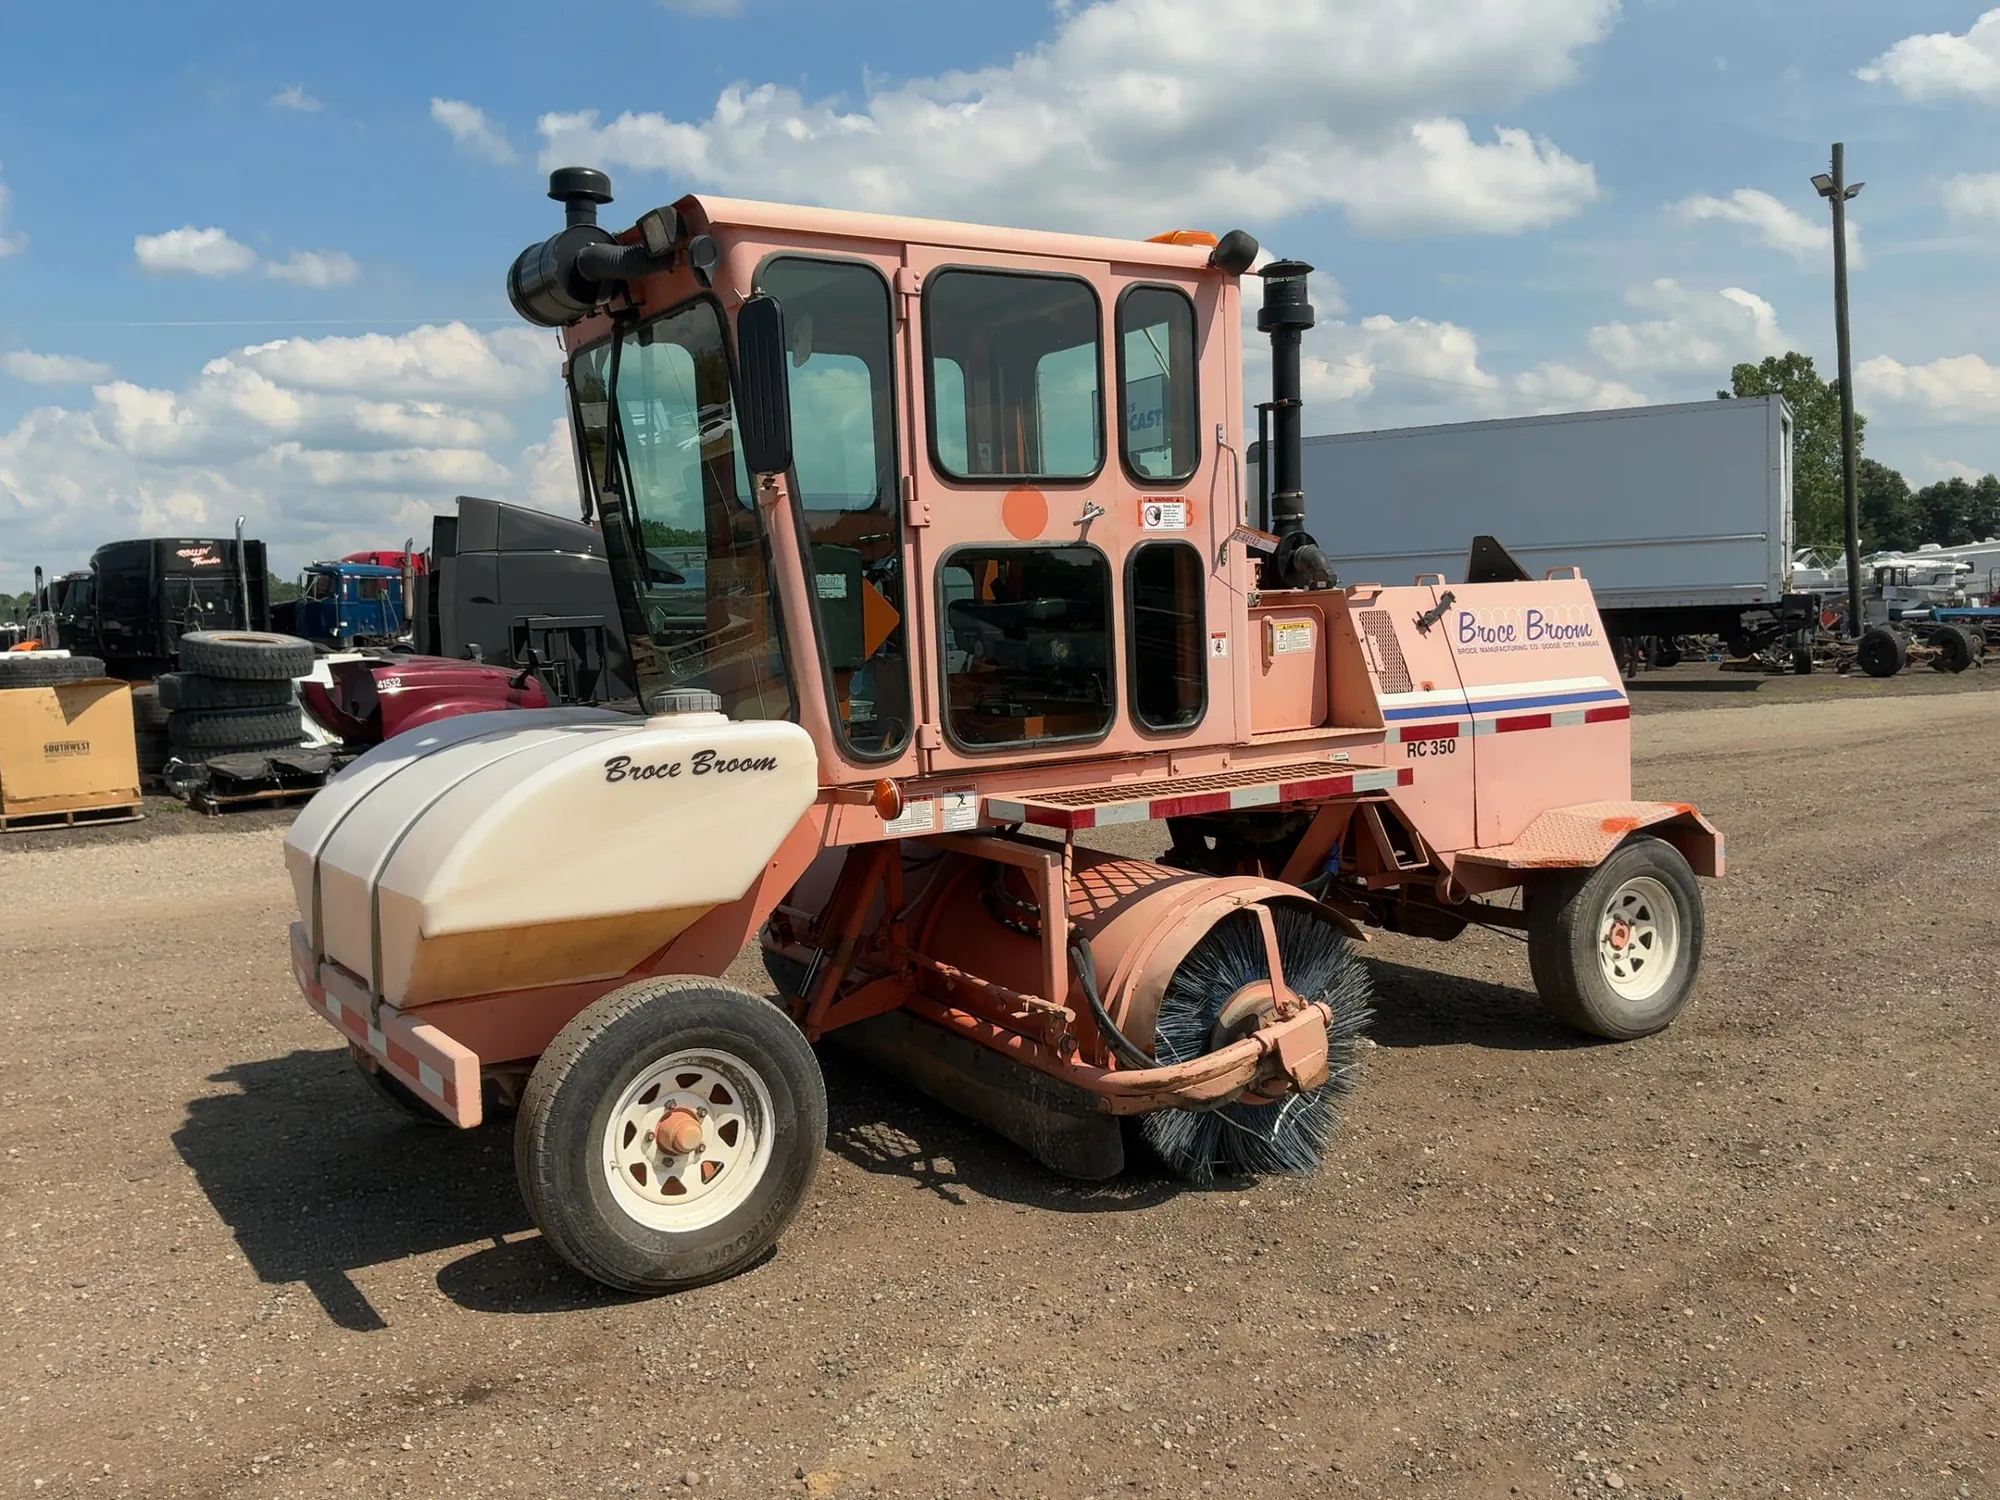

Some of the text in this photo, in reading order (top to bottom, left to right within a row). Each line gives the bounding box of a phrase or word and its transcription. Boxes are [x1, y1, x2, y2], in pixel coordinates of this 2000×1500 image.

[1458, 608, 1593, 644] Broce Broom
[1457, 647, 1478, 655] BROCE
[1480, 644, 1528, 654] MANUFACTURING
[1577, 640, 1599, 648] KANSAS
[377, 677, 402, 689] 41532
[43, 741, 90, 754] SOUTHWEST
[1407, 739, 1456, 758] RC 350
[604, 749, 778, 783] Broce Broom
